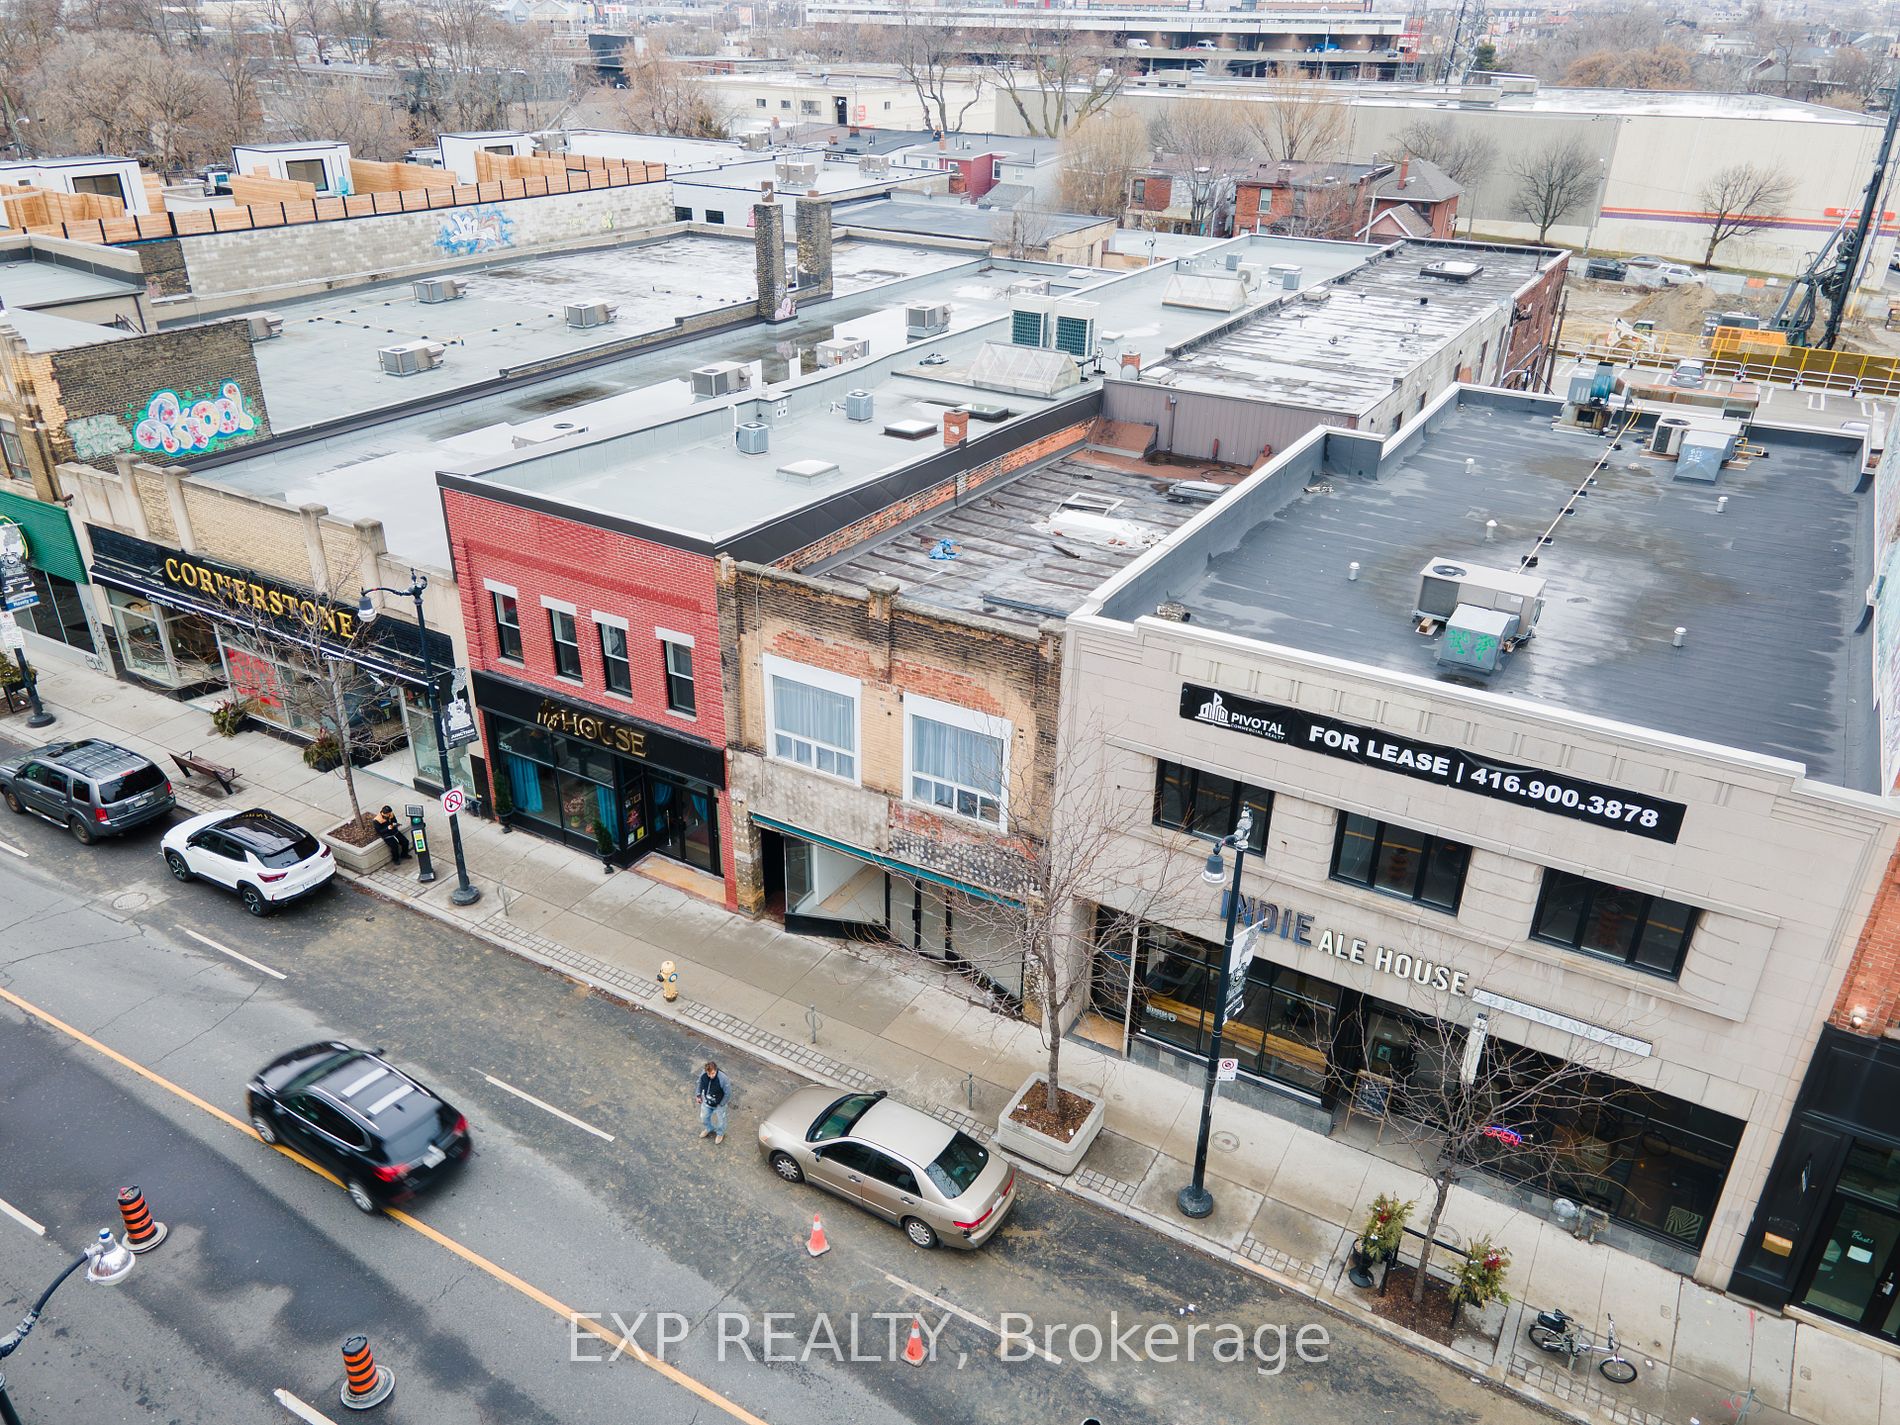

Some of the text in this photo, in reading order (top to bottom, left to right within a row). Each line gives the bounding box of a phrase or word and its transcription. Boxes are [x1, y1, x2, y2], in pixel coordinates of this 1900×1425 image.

[165, 558, 356, 639] CORNERSTONE
[450, 728, 475, 739] JUNCTION
[1230, 723, 1284, 741] COMMERCIAL REALTY
[1231, 712, 1285, 736] PIVOTAL
[1309, 725, 1360, 753] FOR
[1366, 740, 1450, 776] LEASE
[1470, 768, 1659, 827] 416.900.3878
[1220, 888, 1469, 997] INDIE ALE HOUSE
[1484, 1127, 1520, 1147] OPEN
